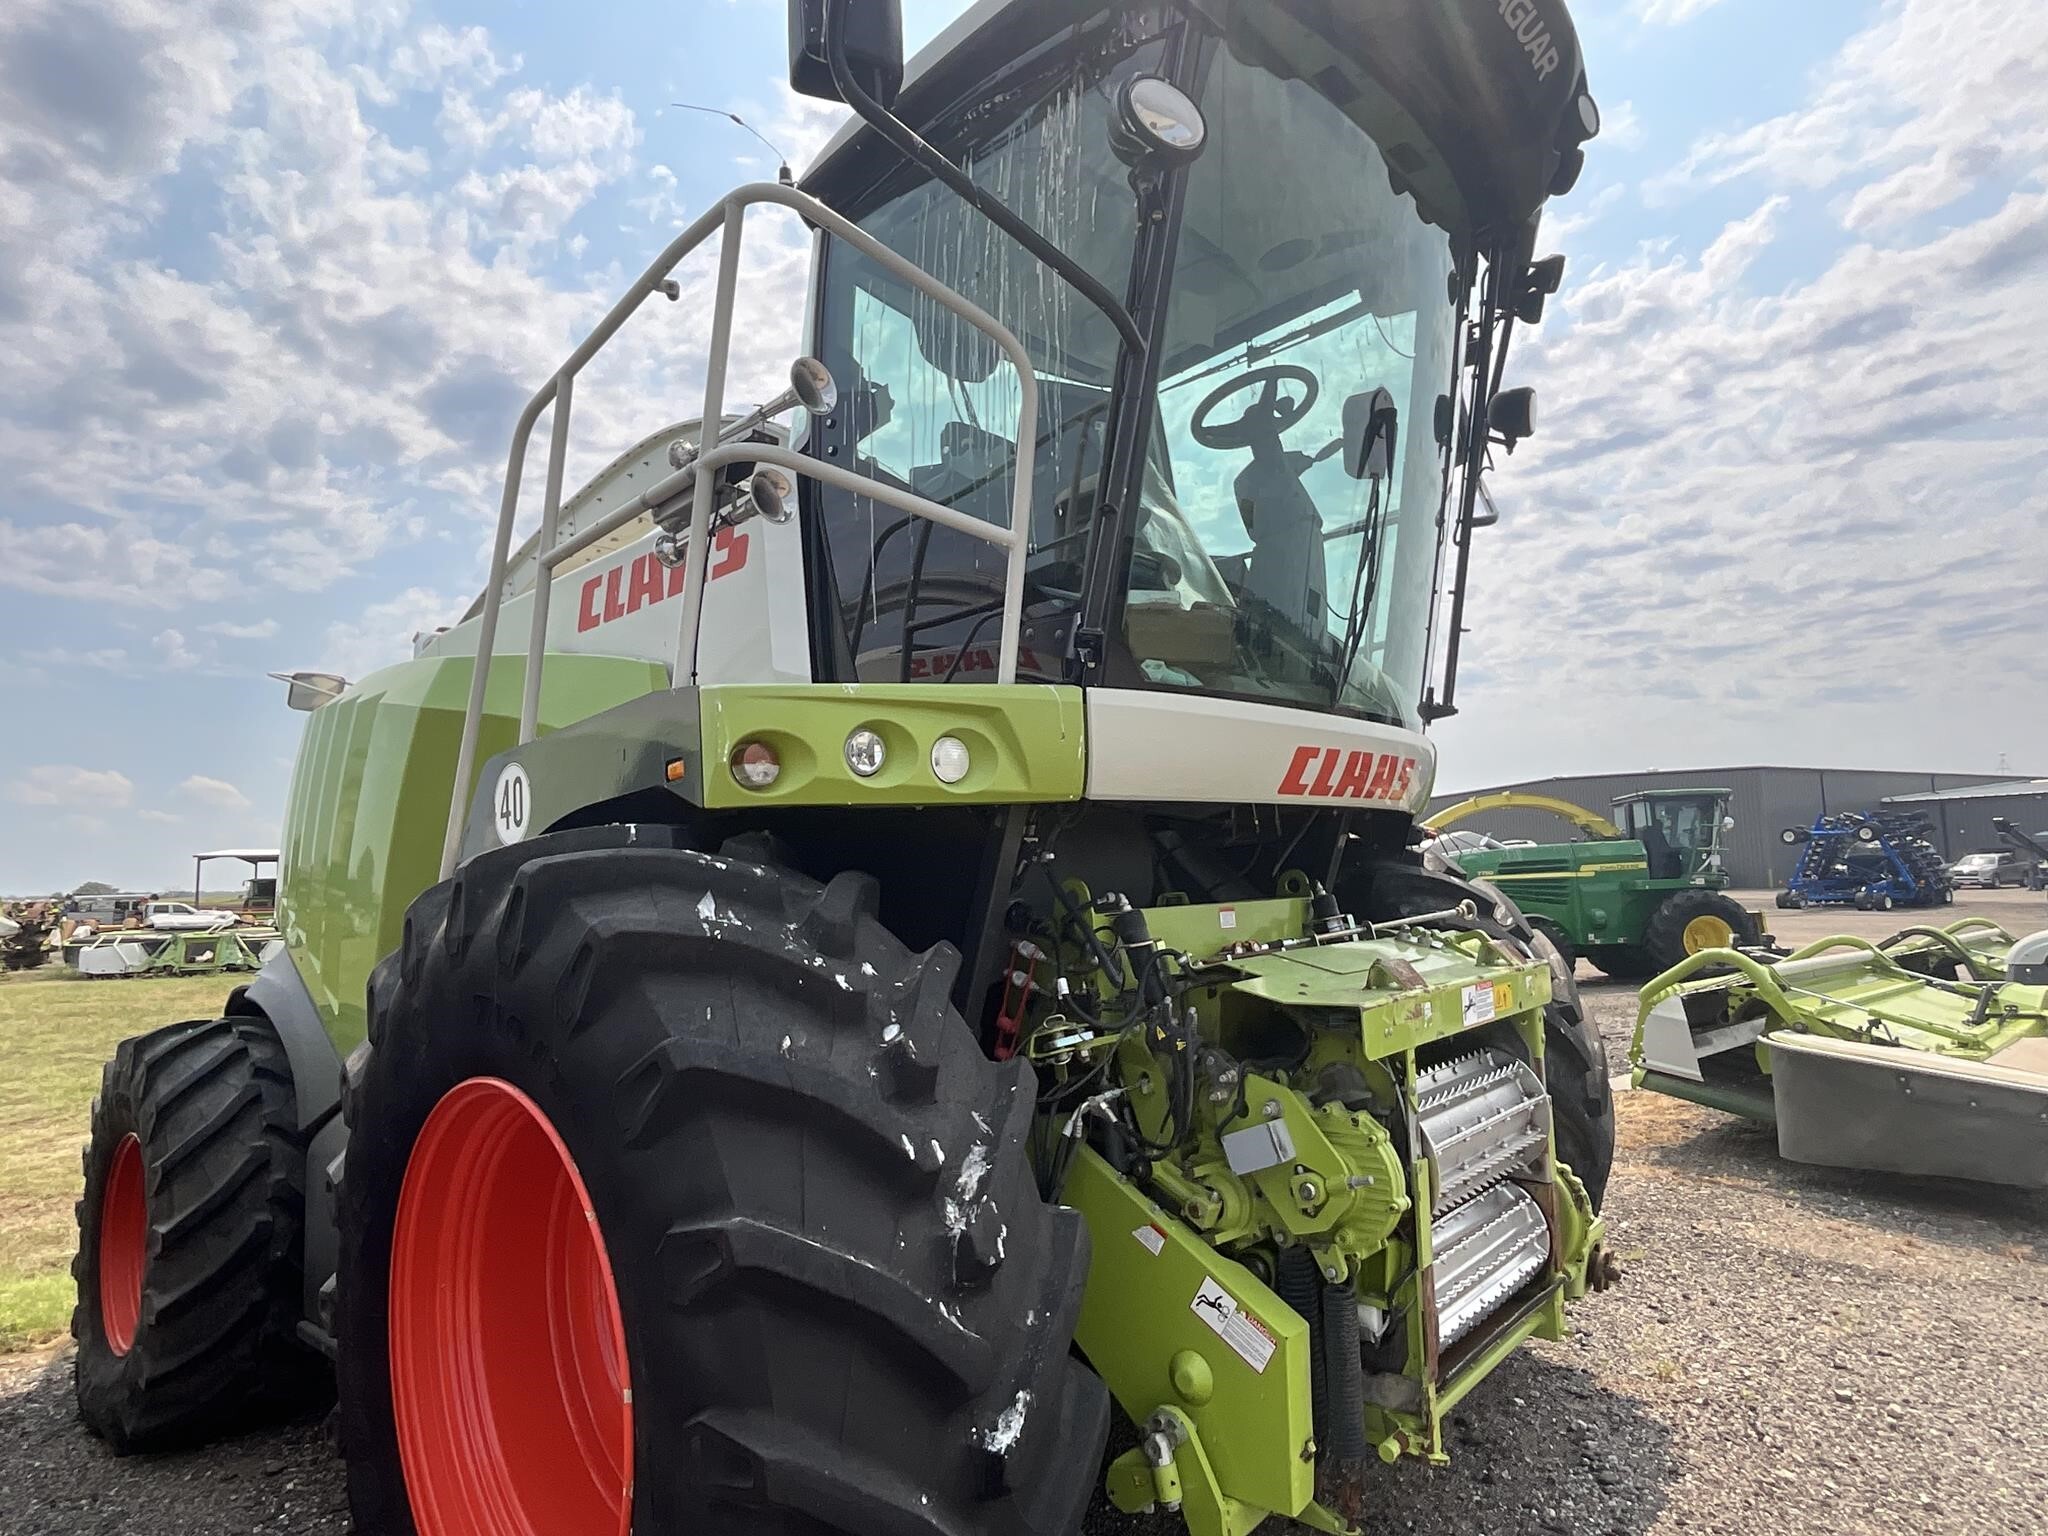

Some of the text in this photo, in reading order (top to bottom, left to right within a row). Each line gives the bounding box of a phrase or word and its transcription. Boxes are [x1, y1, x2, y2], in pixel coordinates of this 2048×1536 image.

[1498, 0, 1560, 82] GUAR
[1277, 746, 1416, 801] CLAAS
[500, 775, 523, 830] 40
